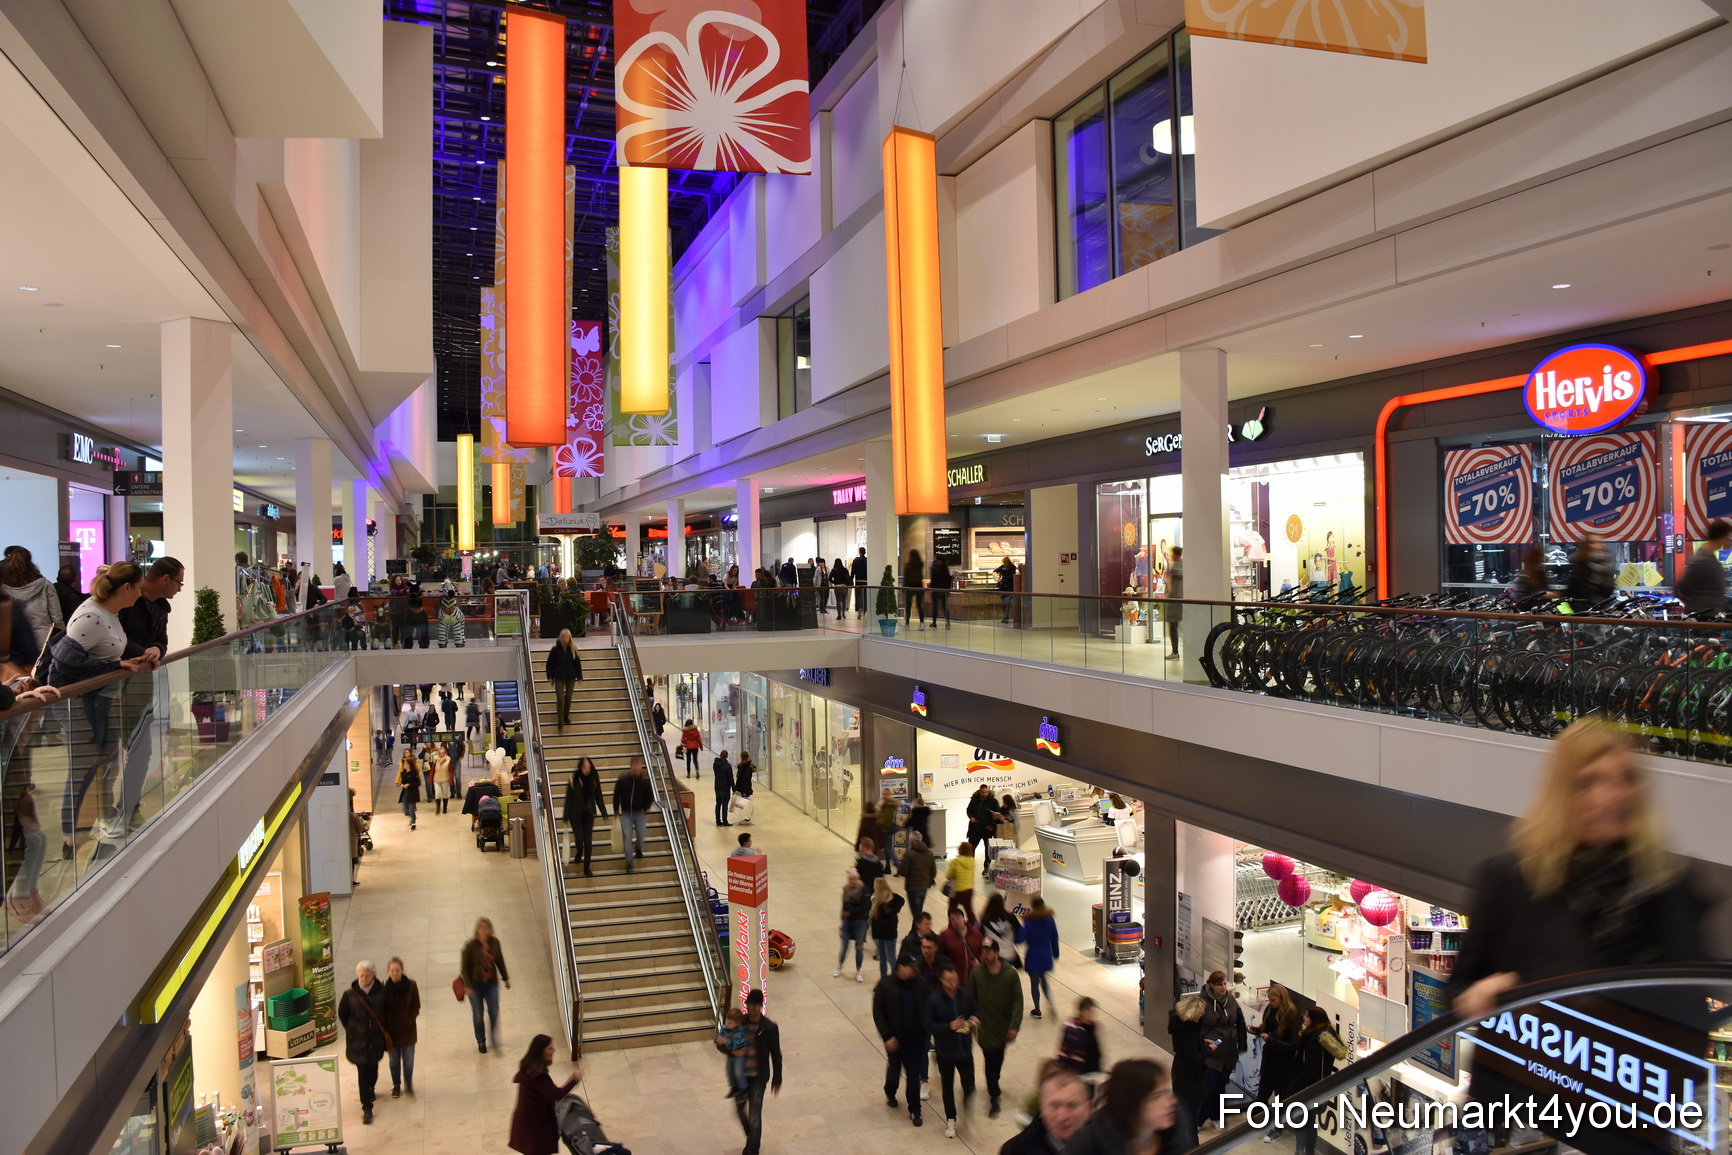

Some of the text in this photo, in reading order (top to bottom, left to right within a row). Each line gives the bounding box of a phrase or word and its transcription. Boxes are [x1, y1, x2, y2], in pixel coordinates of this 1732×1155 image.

[1535, 365, 1634, 413] Hervis
[1544, 407, 1589, 421] SPORTS
[73, 432, 94, 464] EMC
[947, 464, 984, 488] SCHALLER
[832, 487, 854, 505] TALLY
[541, 516, 583, 526] Delizia
[912, 685, 925, 706] dm
[1039, 716, 1058, 743] dm
[884, 755, 904, 769] dm
[943, 779, 959, 789] HIER
[986, 775, 1012, 783] MENSCH
[1027, 778, 1038, 786] EIN
[1052, 850, 1064, 861] dm
[734, 871, 747, 880] finden
[734, 909, 750, 967] Markt
